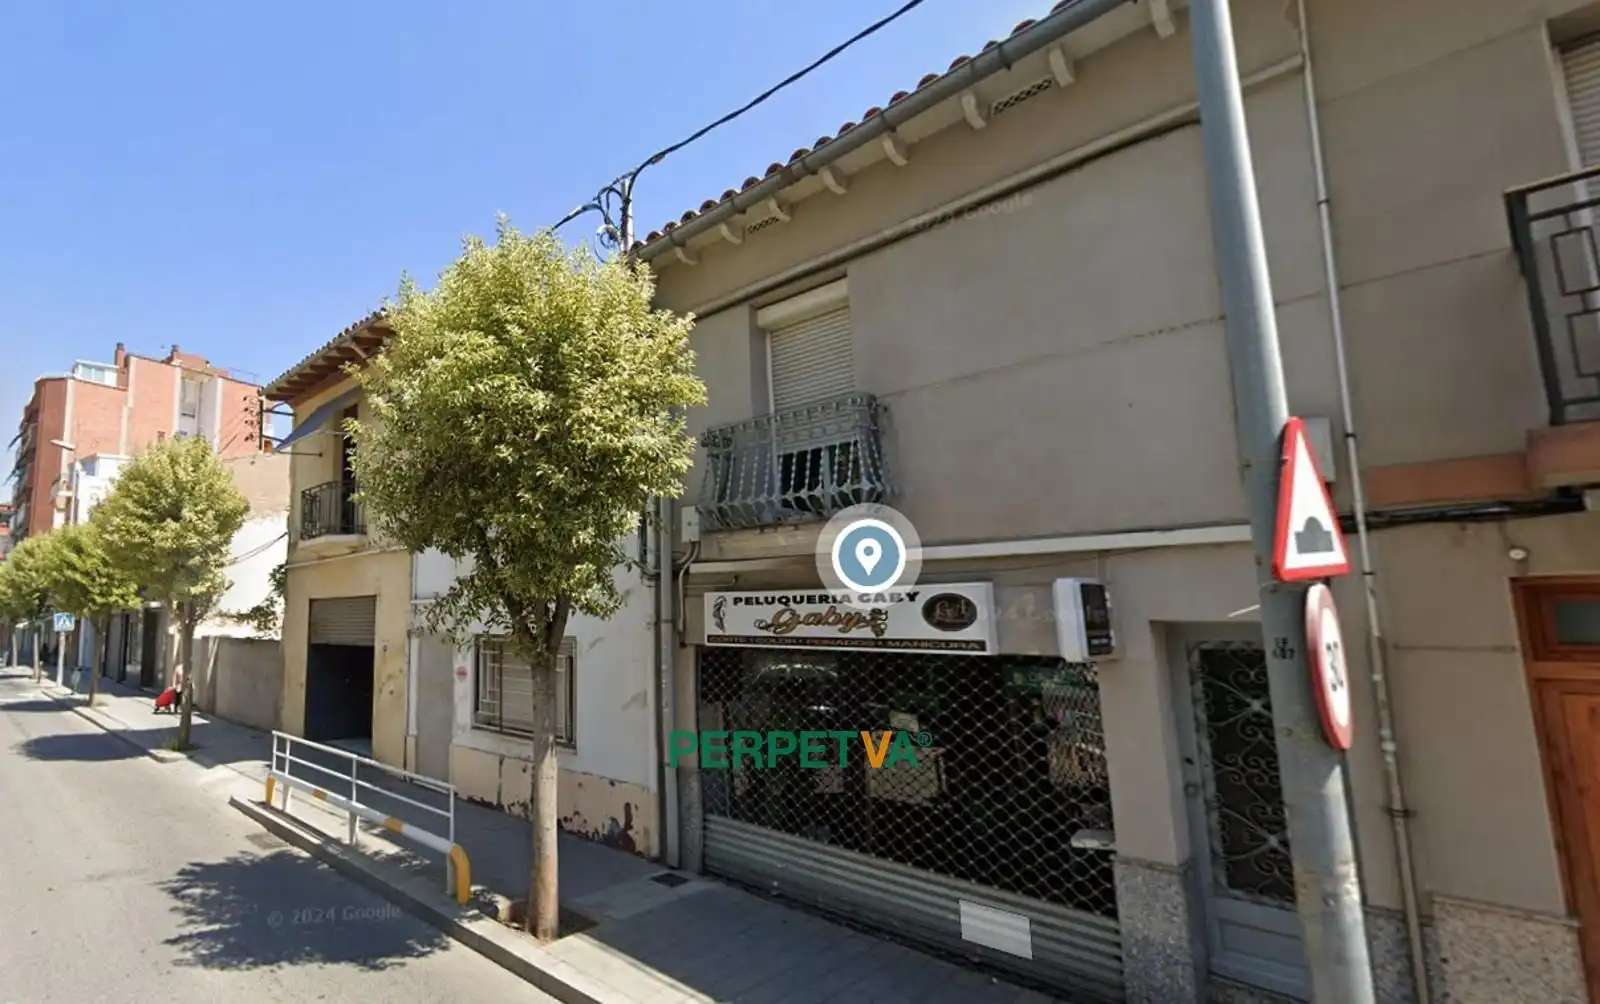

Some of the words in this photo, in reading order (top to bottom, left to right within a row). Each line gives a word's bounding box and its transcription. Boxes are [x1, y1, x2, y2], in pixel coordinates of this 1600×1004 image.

[733, 594, 852, 606] PELUQUERIA
[857, 591, 920, 603] GABY
[767, 605, 867, 635] Gaby
[887, 640, 981, 649] MANICURA
